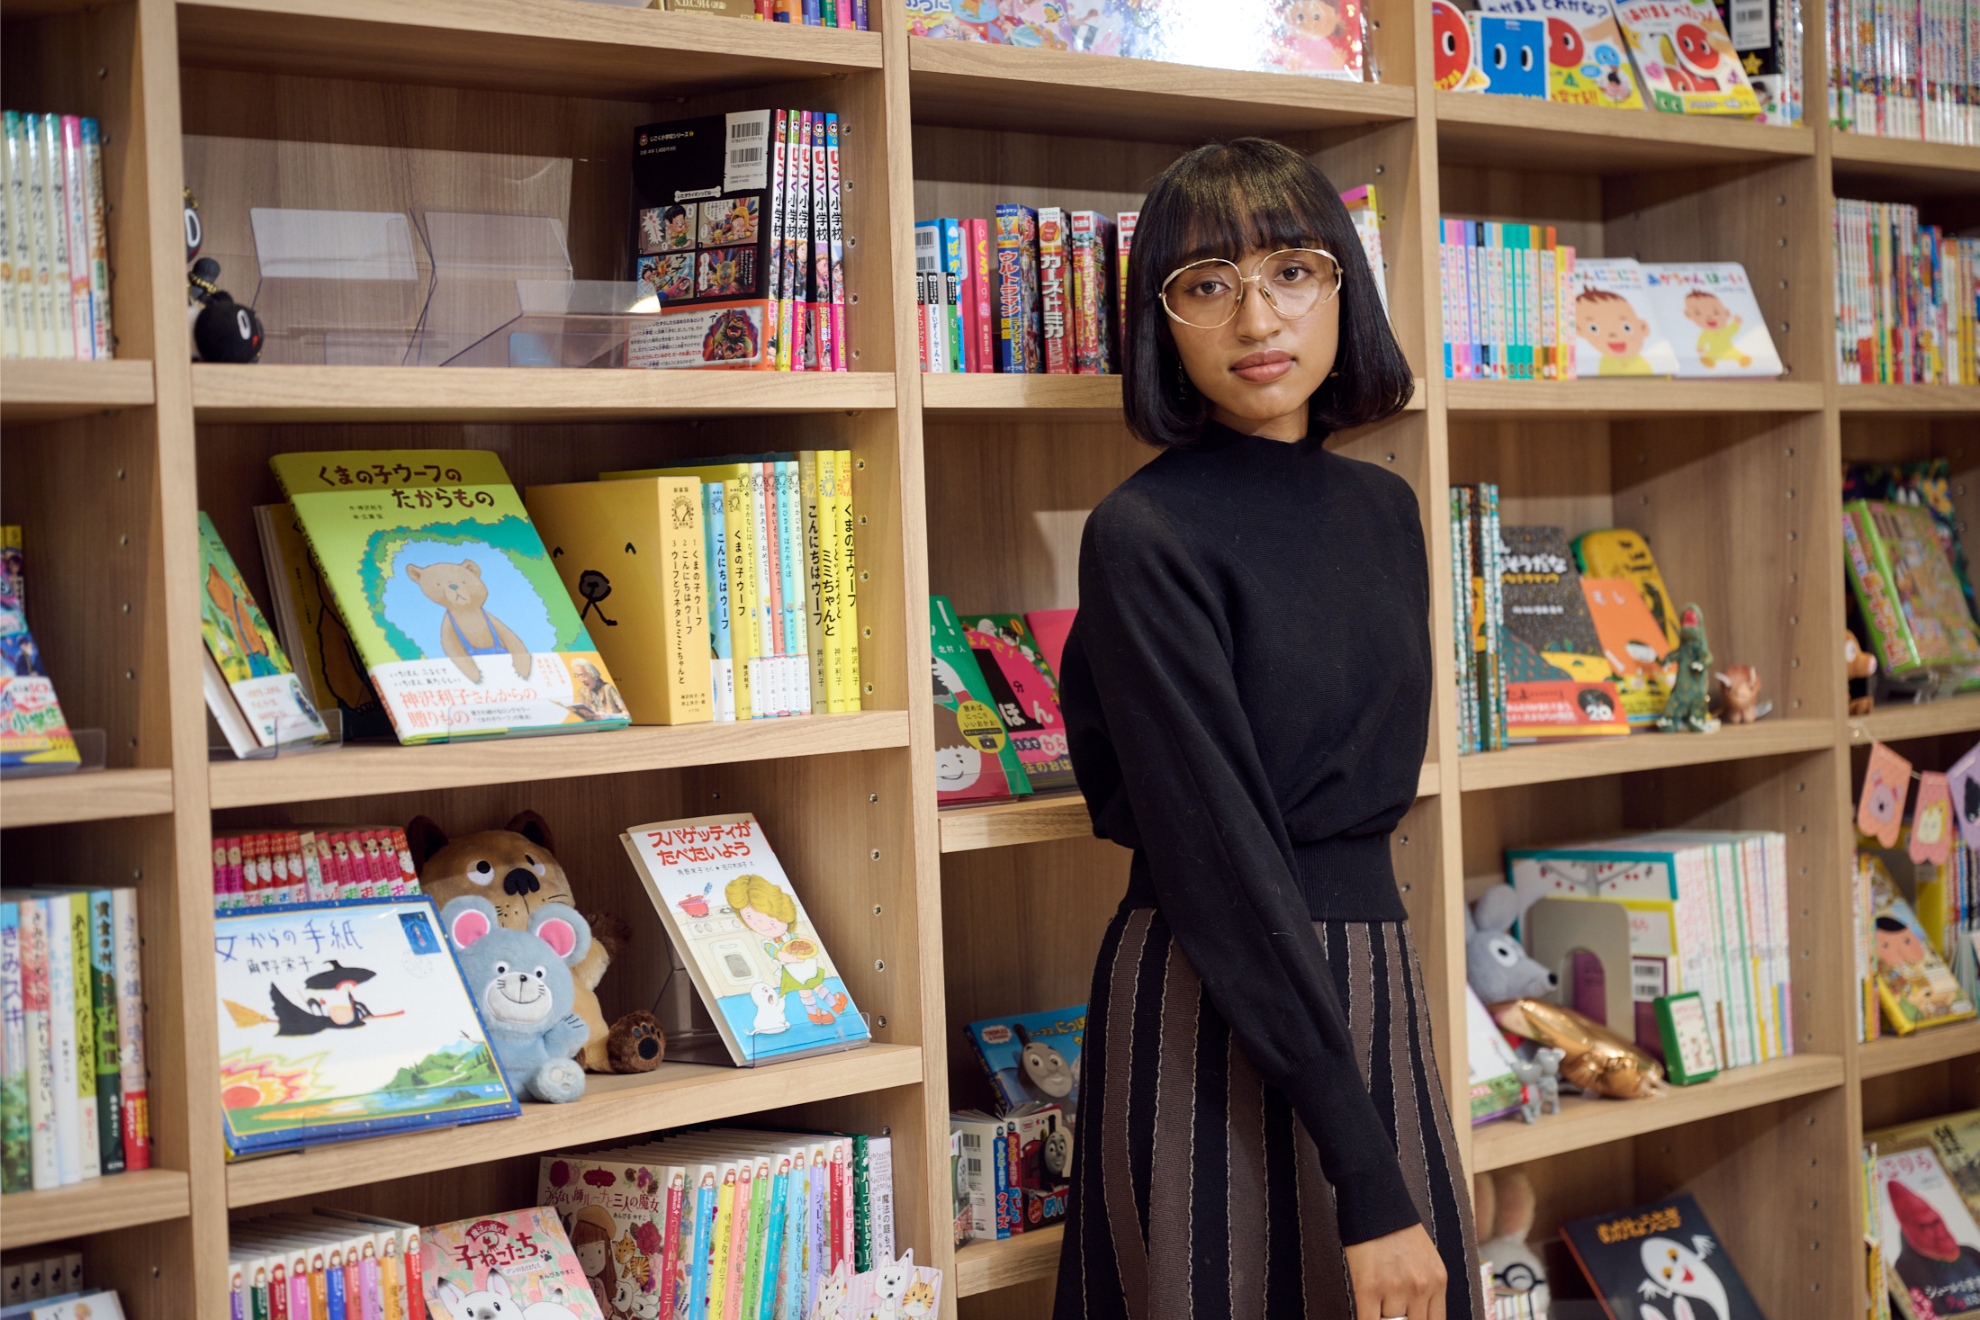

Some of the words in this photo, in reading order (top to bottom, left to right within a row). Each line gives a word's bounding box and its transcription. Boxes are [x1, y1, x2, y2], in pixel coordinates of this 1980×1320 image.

[998, 250, 1020, 318] ウルトラマン
[1040, 254, 1065, 339] カーズトミカ
[318, 464, 463, 487] くまの子ウーフの
[391, 488, 495, 509] たからもの
[735, 530, 747, 617] くまの子ウーフ
[808, 505, 822, 626] こんにちはウーフ
[844, 503, 856, 608] くまの子ウーフ
[716, 533, 729, 630] こんにちはウーフ
[822, 550, 837, 637] ミミちゃんと
[399, 687, 538, 710] 神沢利子さんからの
[407, 710, 471, 729] 贈りもの
[647, 820, 752, 848] スパゲッティが
[656, 841, 751, 867] たべたいよう
[544, 1186, 661, 1214] うらない師ルーナと三人の魔女
[997, 1192, 1010, 1230] クイズ
[1008, 1187, 1021, 1224] めいろ
[1043, 1196, 1068, 1218] めい
[453, 1232, 539, 1271] 子ねこたち
